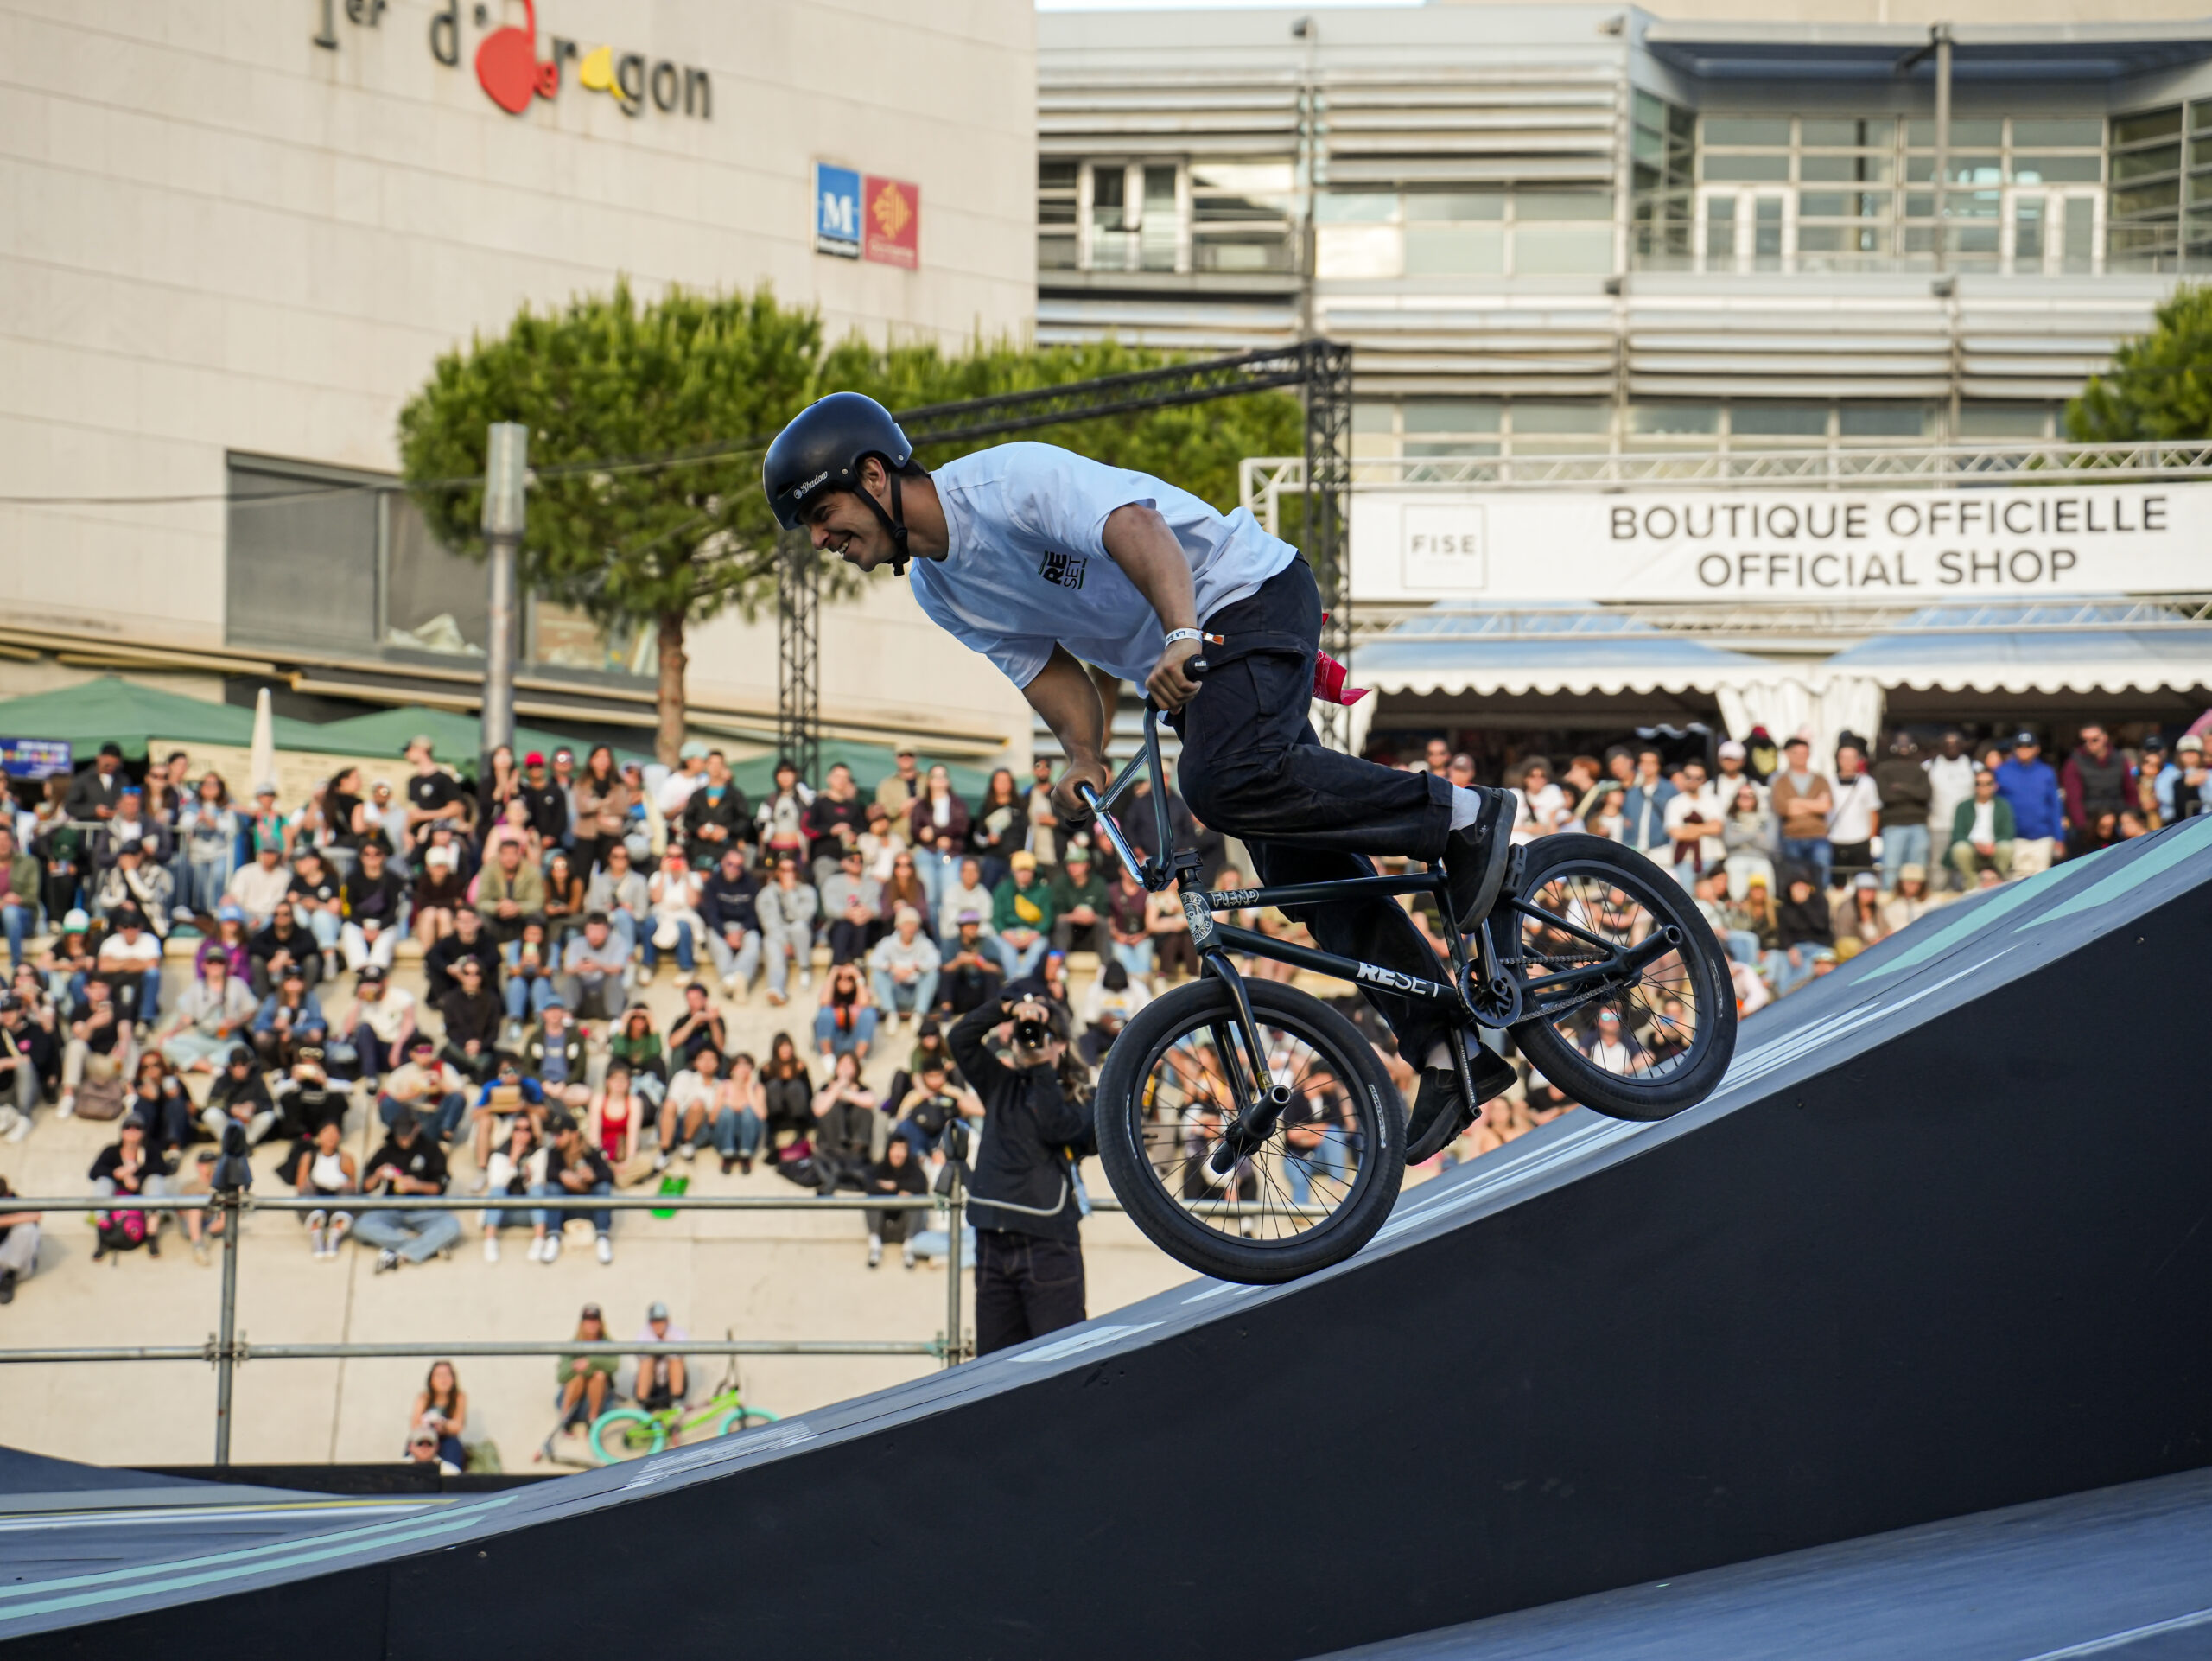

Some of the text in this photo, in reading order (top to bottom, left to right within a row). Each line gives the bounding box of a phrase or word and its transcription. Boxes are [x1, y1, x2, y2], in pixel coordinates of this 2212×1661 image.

[800, 470, 829, 495] Shadow
[1611, 496, 2167, 539] BOUTIQUE OFFICIELLE
[1410, 533, 1475, 555] FISE
[1043, 551, 1068, 585] RE
[1063, 555, 1082, 589] SET
[1698, 548, 2077, 588] OFFICIAL SHOP
[1211, 888, 1260, 908] FIEND
